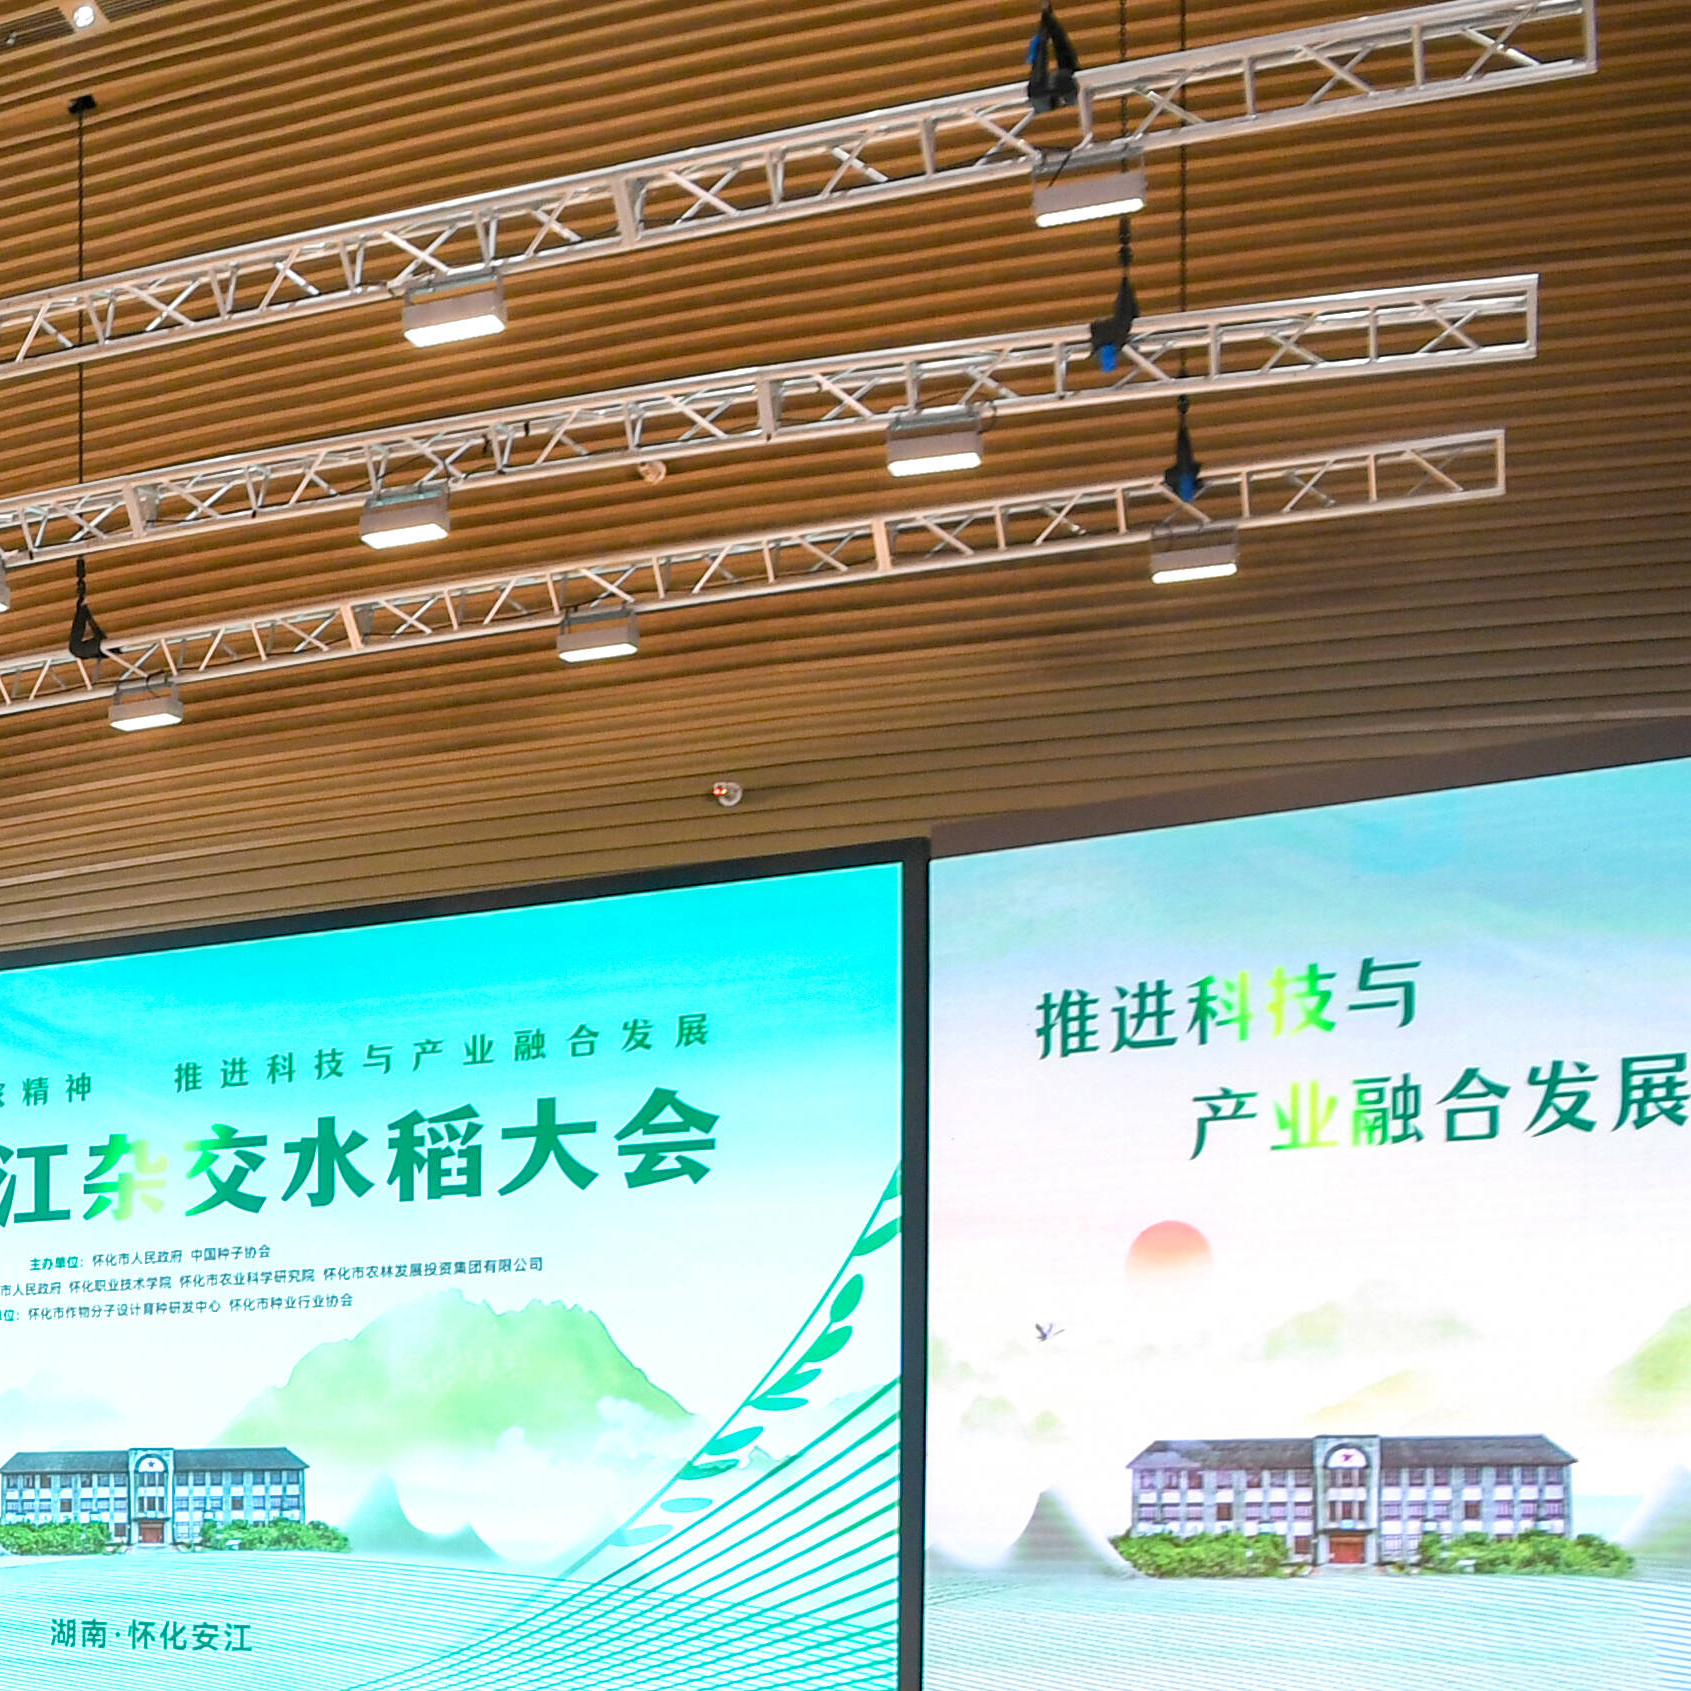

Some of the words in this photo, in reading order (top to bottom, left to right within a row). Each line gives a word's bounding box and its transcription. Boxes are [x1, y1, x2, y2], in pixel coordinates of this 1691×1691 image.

[1034, 956, 1422, 1061] 推进科技与
[174, 1013, 709, 1094] 推进科技与产业融合发展
[1188, 1052, 1691, 1161] 产业融合发展
[92, 1250, 183, 1268] 怀化市人民政府
[191, 1244, 271, 1263] 中国种子协会
[69, 1276, 172, 1294] 怀化职业技术学院
[179, 1268, 315, 1289] 怀化市农业科学研究院
[229, 1293, 354, 1312] 怀化市种业行业协会
[50, 1618, 253, 1652] 湖南·怀化安江
